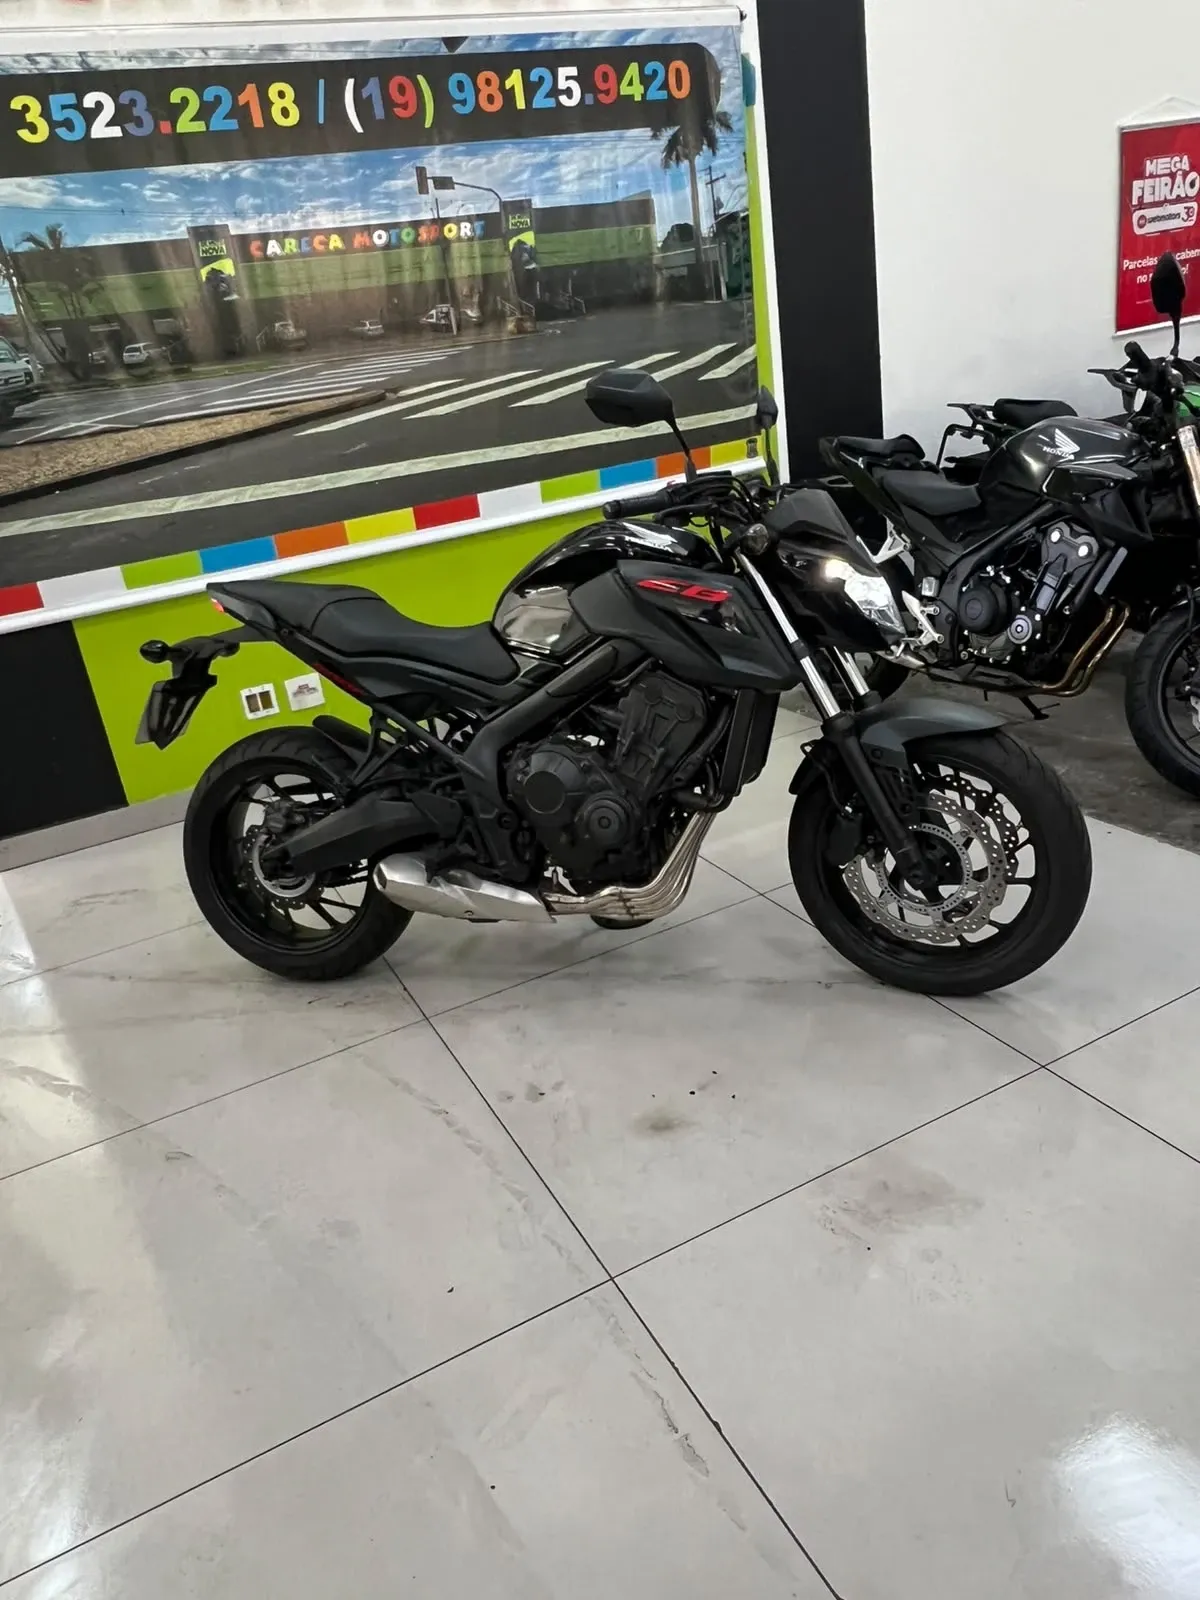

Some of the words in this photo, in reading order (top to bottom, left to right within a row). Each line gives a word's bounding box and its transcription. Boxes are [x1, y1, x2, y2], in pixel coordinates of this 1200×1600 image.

[10, 82, 300, 144] 3523.2218
[344, 75, 434, 133] (19)
[448, 60, 691, 115] 98125.9420
[1145, 155, 1190, 177] MEGA
[1132, 171, 1200, 205] FEIRÃO
[250, 234, 345, 258] CARECA
[353, 220, 485, 249] MOTOSPORT
[1123, 256, 1158, 271] Parcelas
[1137, 274, 1148, 284] no
